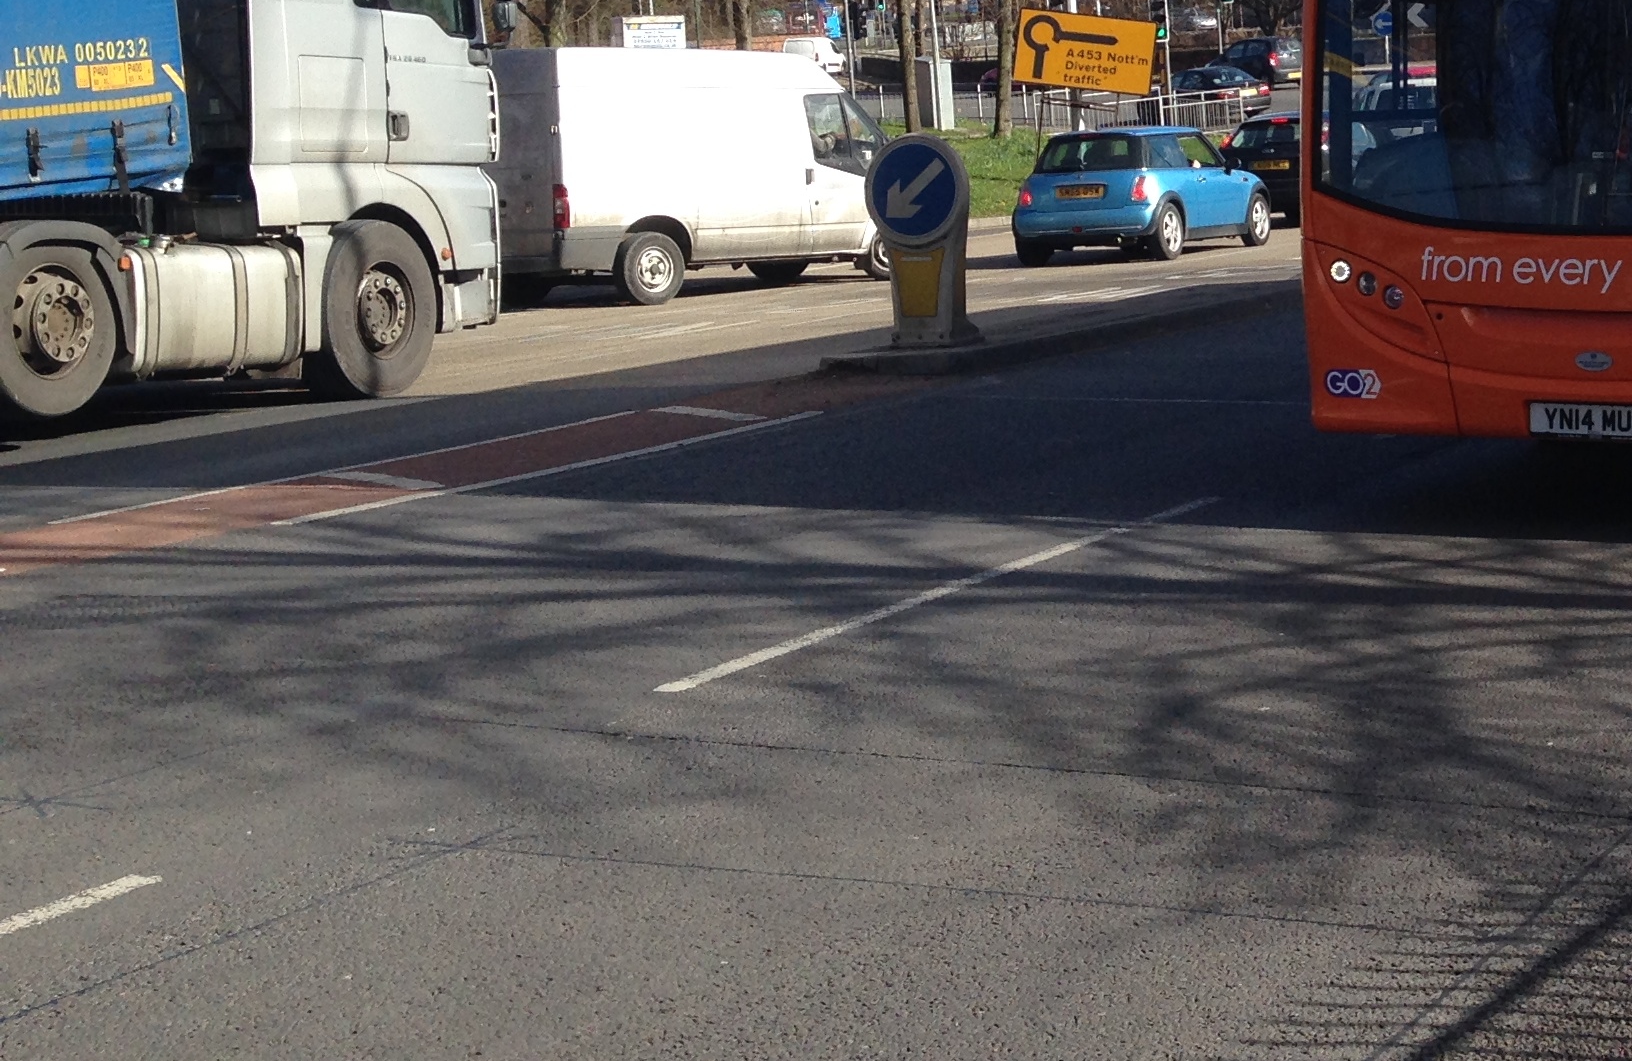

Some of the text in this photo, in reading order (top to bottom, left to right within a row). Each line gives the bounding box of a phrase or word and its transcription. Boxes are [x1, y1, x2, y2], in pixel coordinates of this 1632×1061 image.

[14, 37, 149, 67] LKWA 0050232
[1066, 47, 1149, 66] A453 Nott'm
[1063, 73, 1102, 86] traffic
[1065, 60, 1117, 75] Diverted
[0, 67, 62, 99] -KM5023
[1421, 247, 1502, 282] from
[1512, 256, 1622, 294] every
[1326, 370, 1380, 397] GO2
[1544, 407, 1595, 431] YN14
